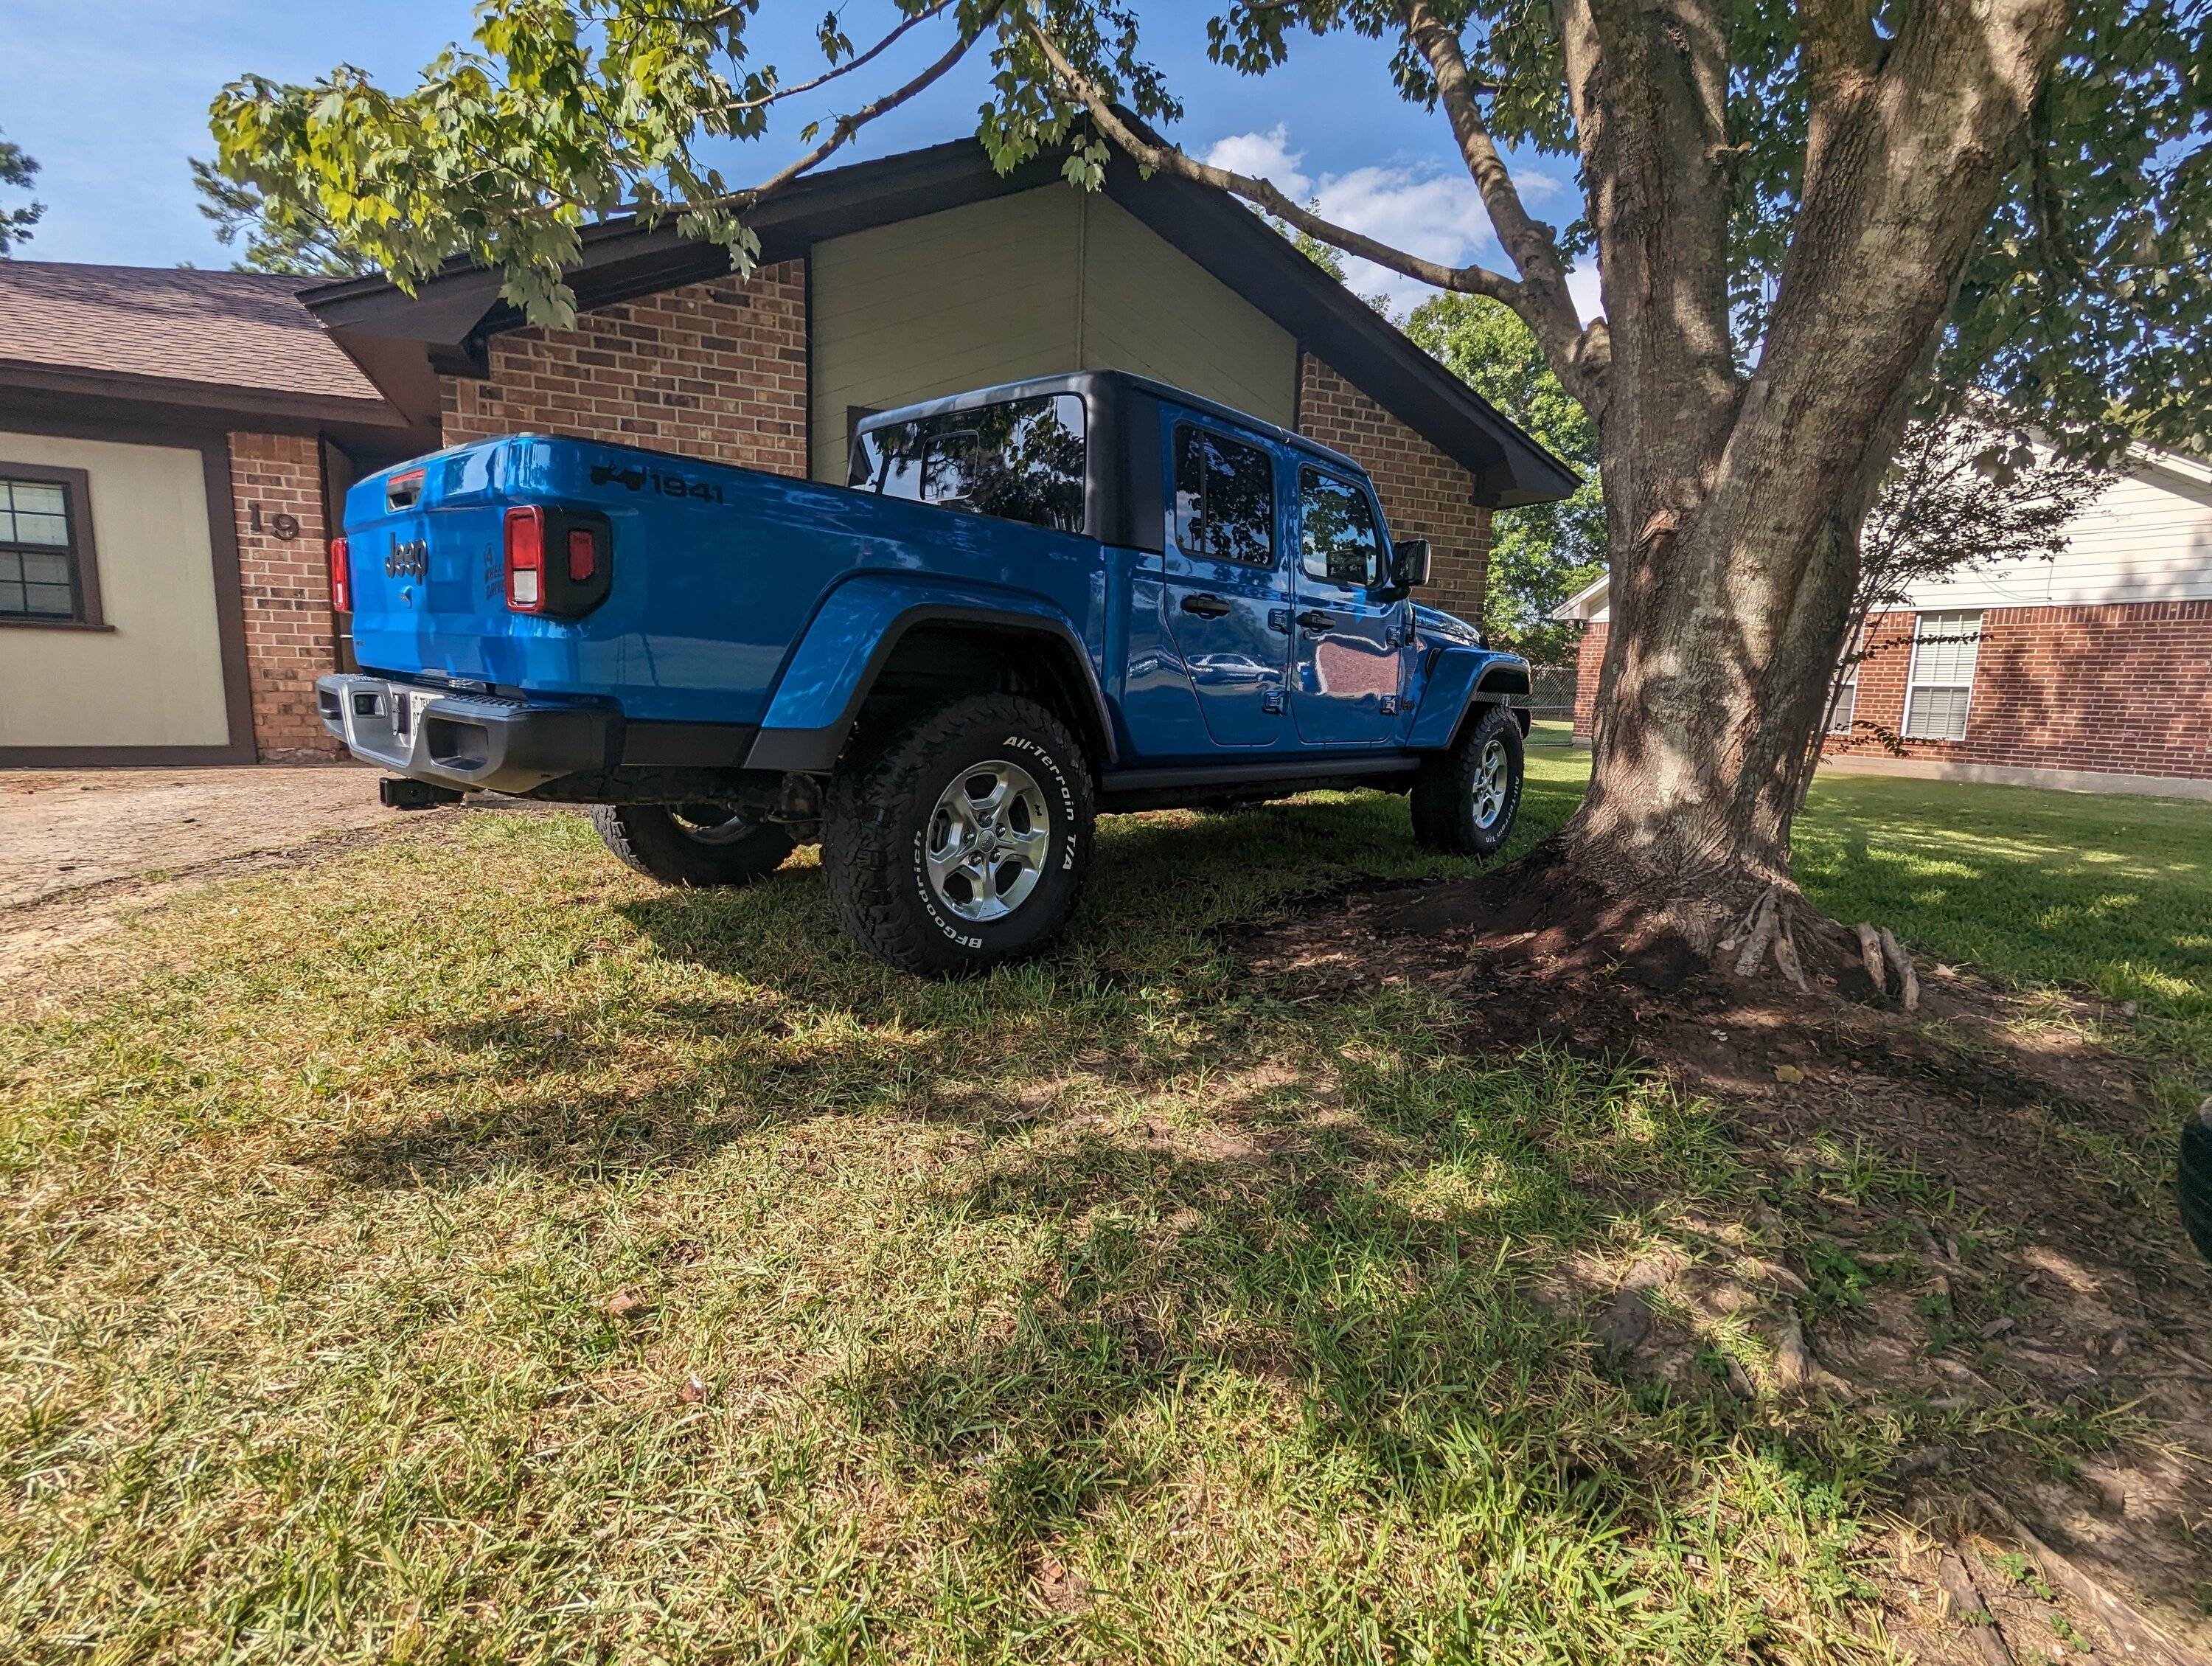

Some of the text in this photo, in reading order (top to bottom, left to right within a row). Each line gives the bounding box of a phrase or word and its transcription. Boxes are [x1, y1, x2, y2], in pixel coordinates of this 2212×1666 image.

[650, 473, 724, 504] 1941
[248, 501, 299, 541] 19
[385, 531, 428, 586] Jeep
[1003, 736, 1077, 870] All-Terrain T/A
[914, 830, 983, 948] BFGoodrich
